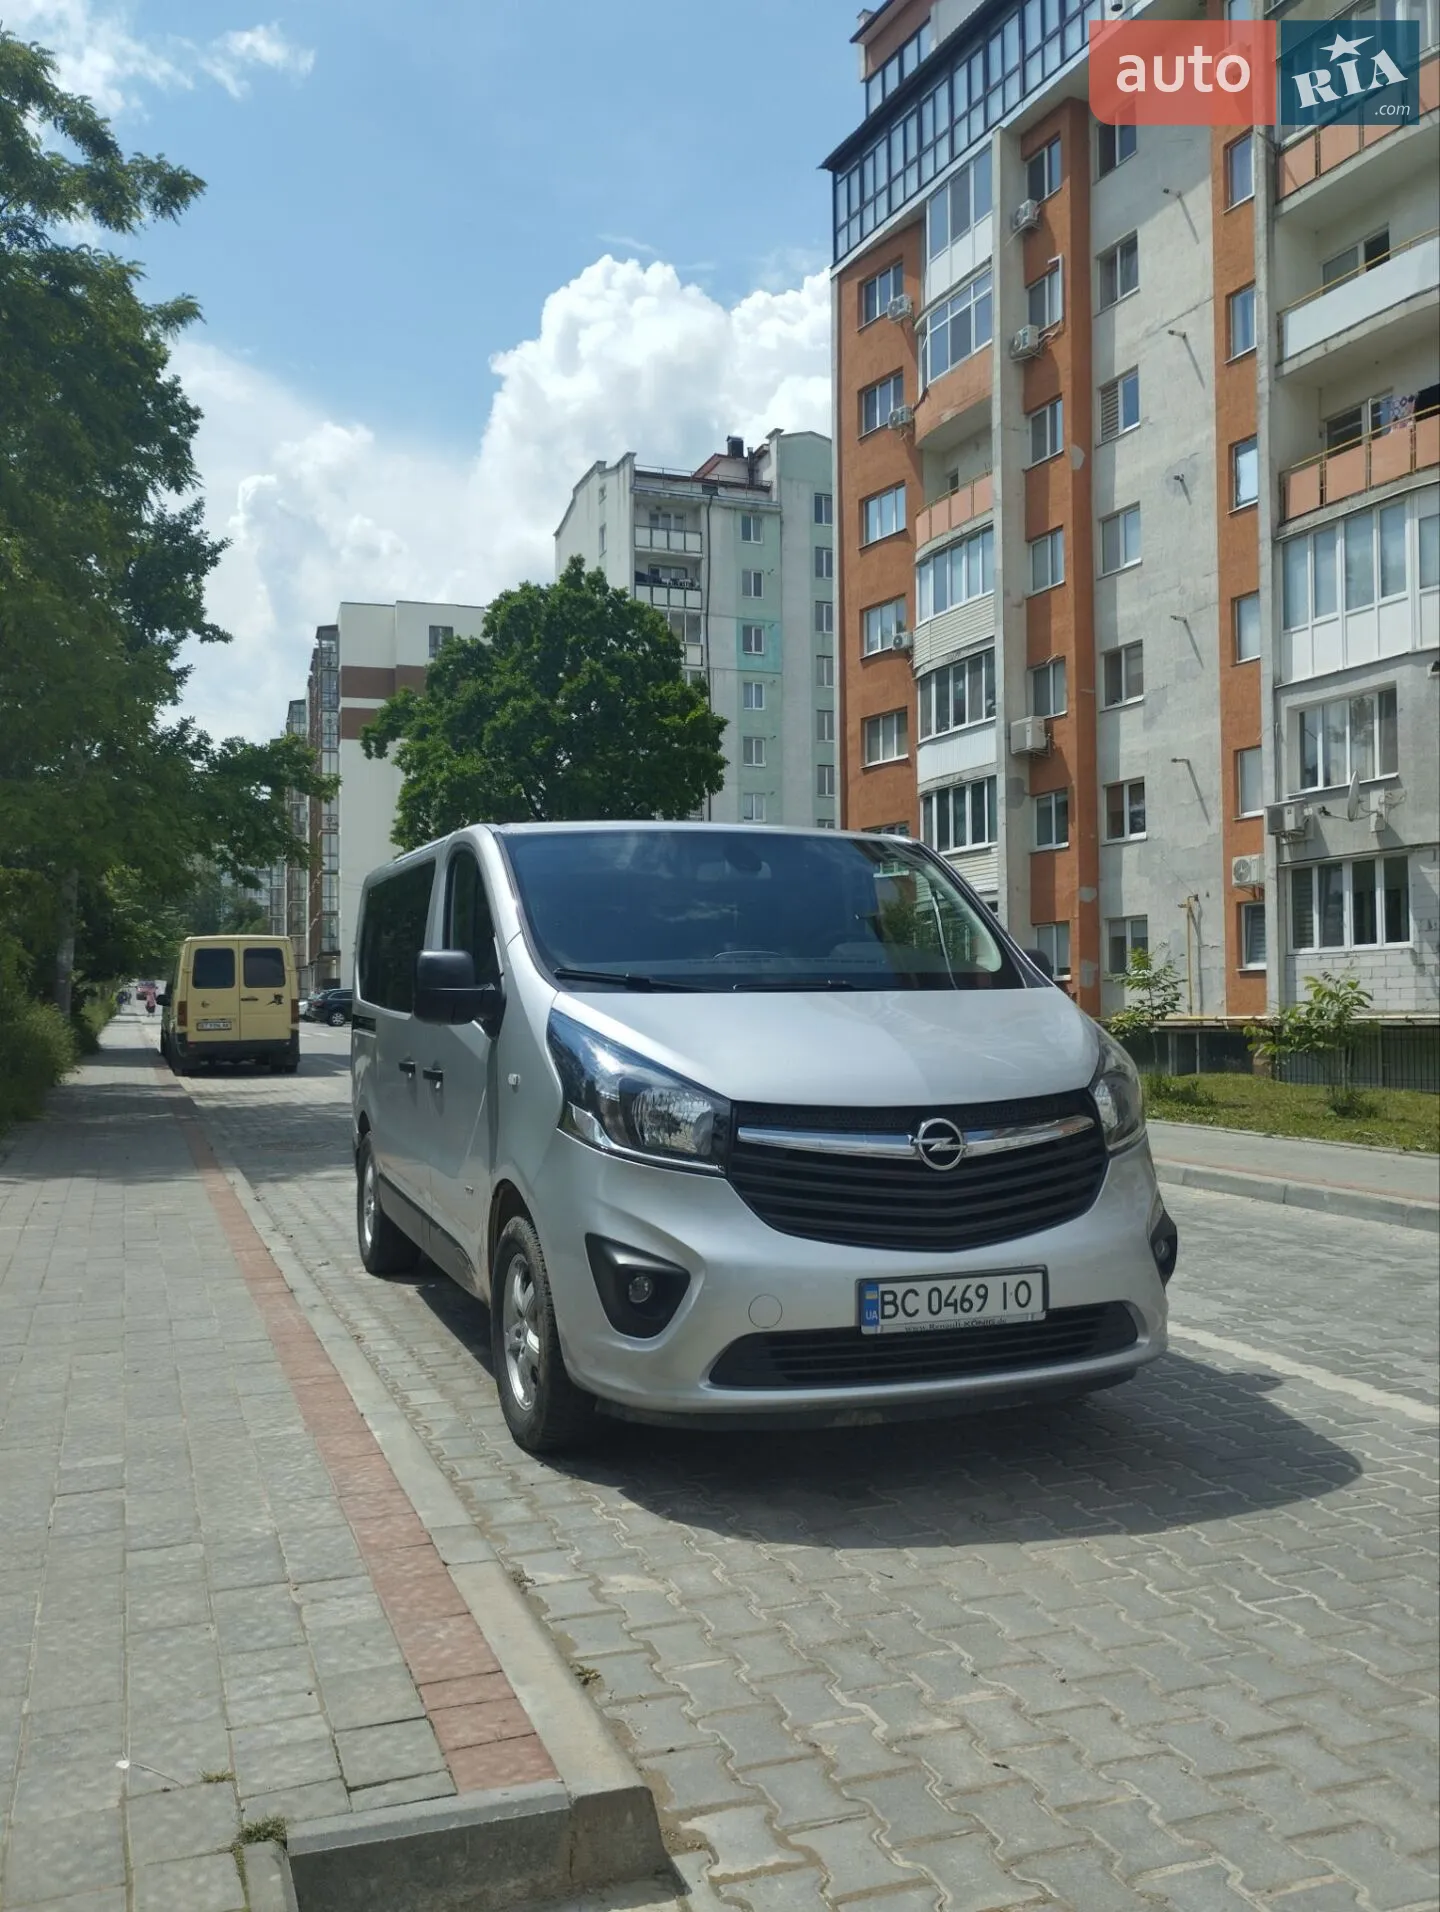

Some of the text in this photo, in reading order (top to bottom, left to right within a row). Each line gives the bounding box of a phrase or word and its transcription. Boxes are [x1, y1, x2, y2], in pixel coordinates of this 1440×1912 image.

[880, 1280, 1032, 1320] BC 0469 IO
[866, 1311, 878, 1321] UA
